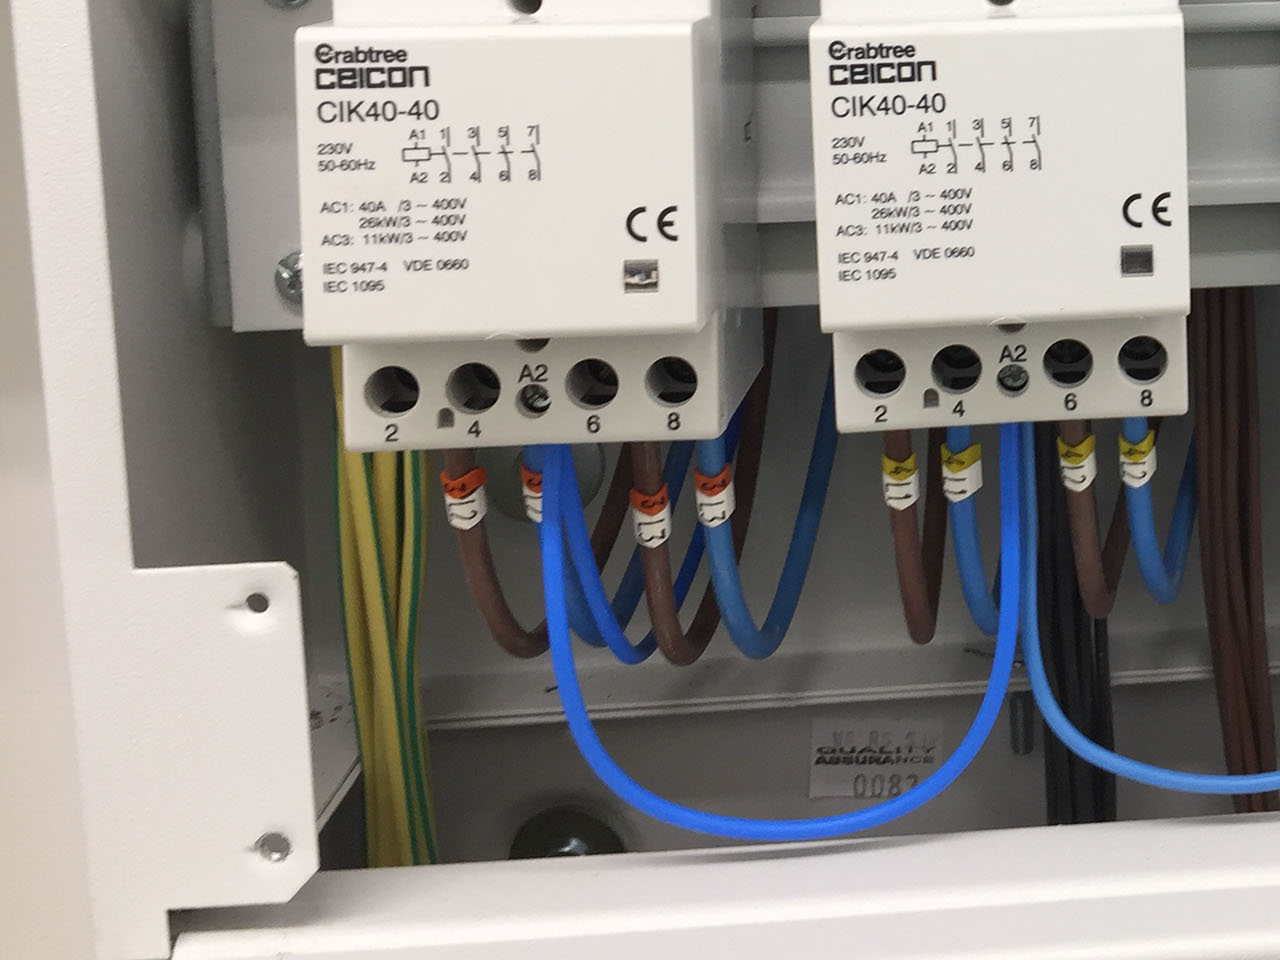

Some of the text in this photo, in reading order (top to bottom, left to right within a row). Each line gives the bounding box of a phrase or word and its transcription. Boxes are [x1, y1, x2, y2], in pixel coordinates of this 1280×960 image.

[315, 44, 407, 64] Crabtree
[828, 41, 916, 60] Crabtree
[317, 100, 439, 123] CIK40-40
[832, 93, 946, 118] CIK40-40
[318, 143, 352, 155] 230V
[832, 136, 865, 149] 230V
[318, 159, 375, 172] 50-60Hz
[833, 152, 886, 165] 50-60Hz
[835, 193, 866, 205] AC1:
[871, 192, 897, 203] 40A
[940, 188, 972, 200] 400V
[320, 201, 353, 213] AC1:
[359, 201, 386, 212] 40A
[432, 198, 467, 210] 400V
[940, 203, 972, 215] 400V
[432, 214, 466, 226] 400V
[836, 225, 867, 236] AC3:
[941, 219, 973, 231] 400V
[321, 234, 354, 246] AC3:
[434, 231, 467, 242] 400V
[838, 247, 975, 264] IEC 947-4 VDE 0660
[323, 259, 469, 274] IEC 947-4 VDE 0660
[839, 268, 896, 281] IEC 1095
[323, 280, 385, 293] IEC 1095
[999, 345, 1027, 363] A2
[518, 364, 548, 382] A2
[875, 389, 1153, 423] 2 4 6 8
[385, 412, 680, 442] 2 4 6 8
